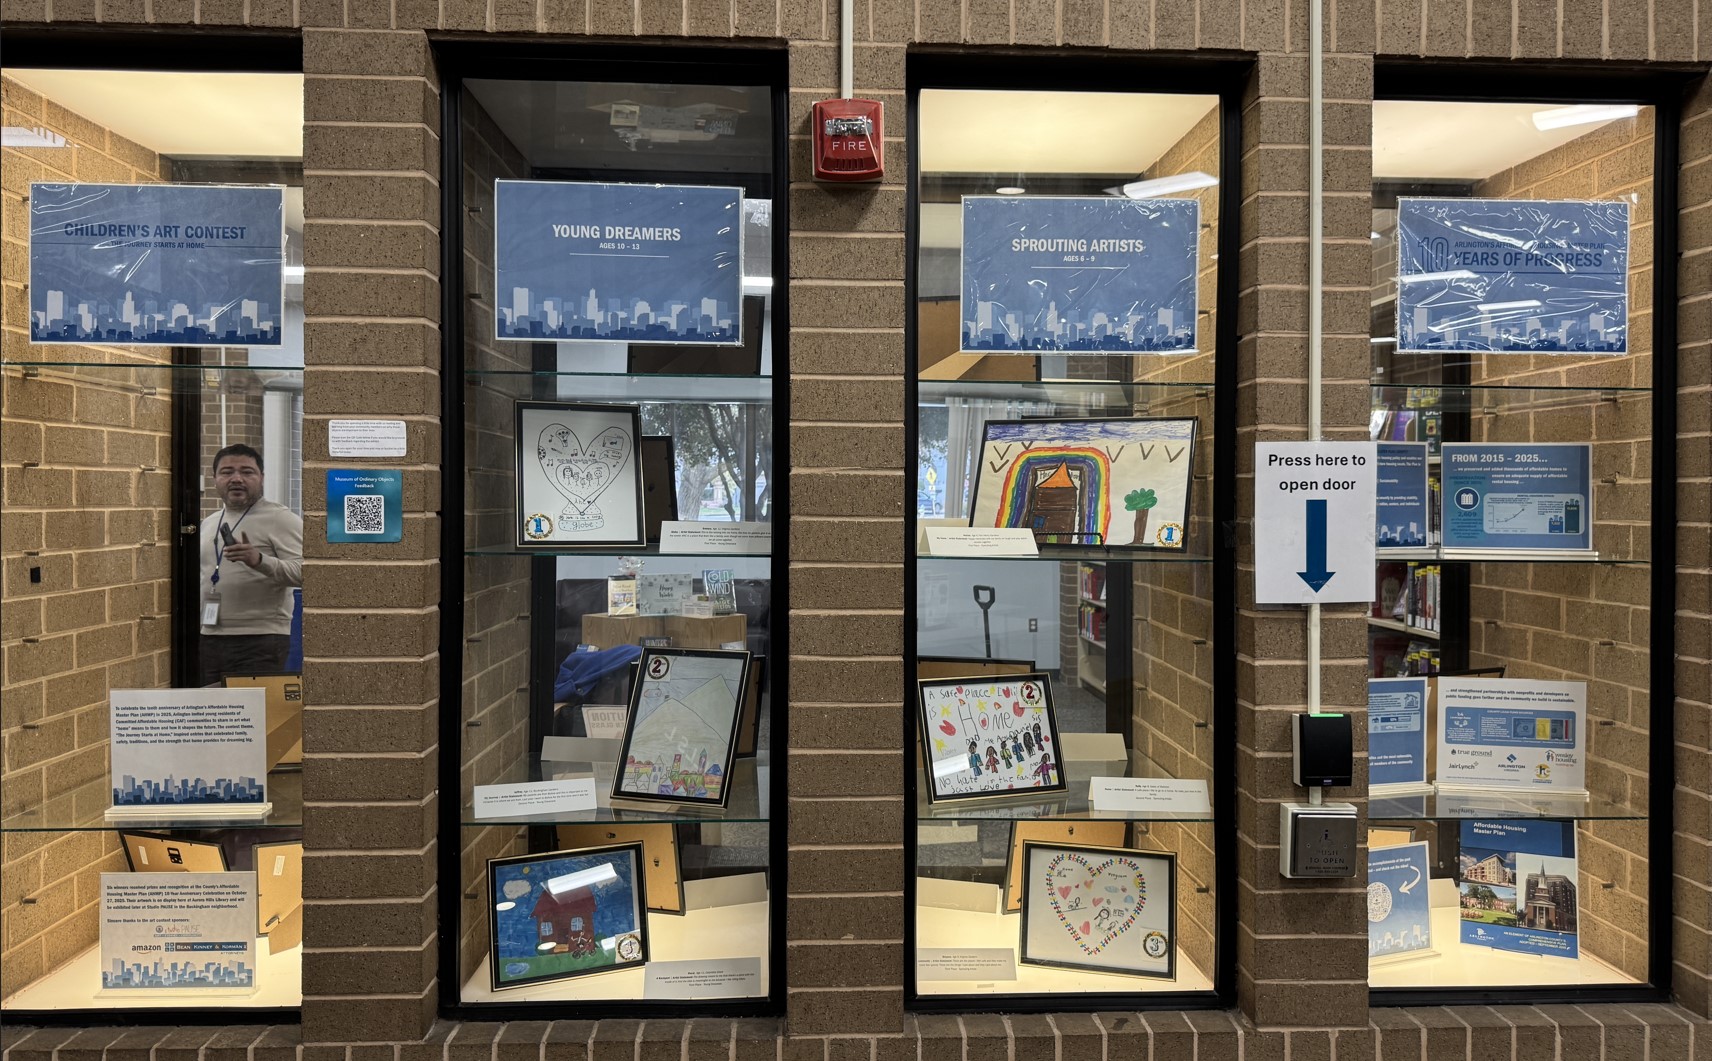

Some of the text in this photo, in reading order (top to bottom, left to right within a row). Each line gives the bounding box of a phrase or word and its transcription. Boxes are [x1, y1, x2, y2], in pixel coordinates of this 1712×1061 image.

[832, 141, 866, 150] FIRE
[153, 225, 180, 238] ART
[185, 226, 246, 239] CONTEST
[552, 224, 681, 241] YOUNG DREAMERS
[1012, 238, 1143, 252] SPROUTING ARTISTS
[1418, 237, 1448, 272] 10
[1454, 252, 1602, 267] YEARS OF PROGRESS
[1268, 454, 1366, 466] Press here to
[1452, 454, 1478, 463] FROM
[1480, 454, 1504, 463] 2015
[1515, 454, 1548, 463] 2025...
[1279, 478, 1356, 493] open door
[708, 571, 729, 582] COLD
[708, 583, 730, 594] WIND
[929, 691, 935, 699] A
[939, 777, 951, 790] No
[1503, 825, 1526, 833] Housing
